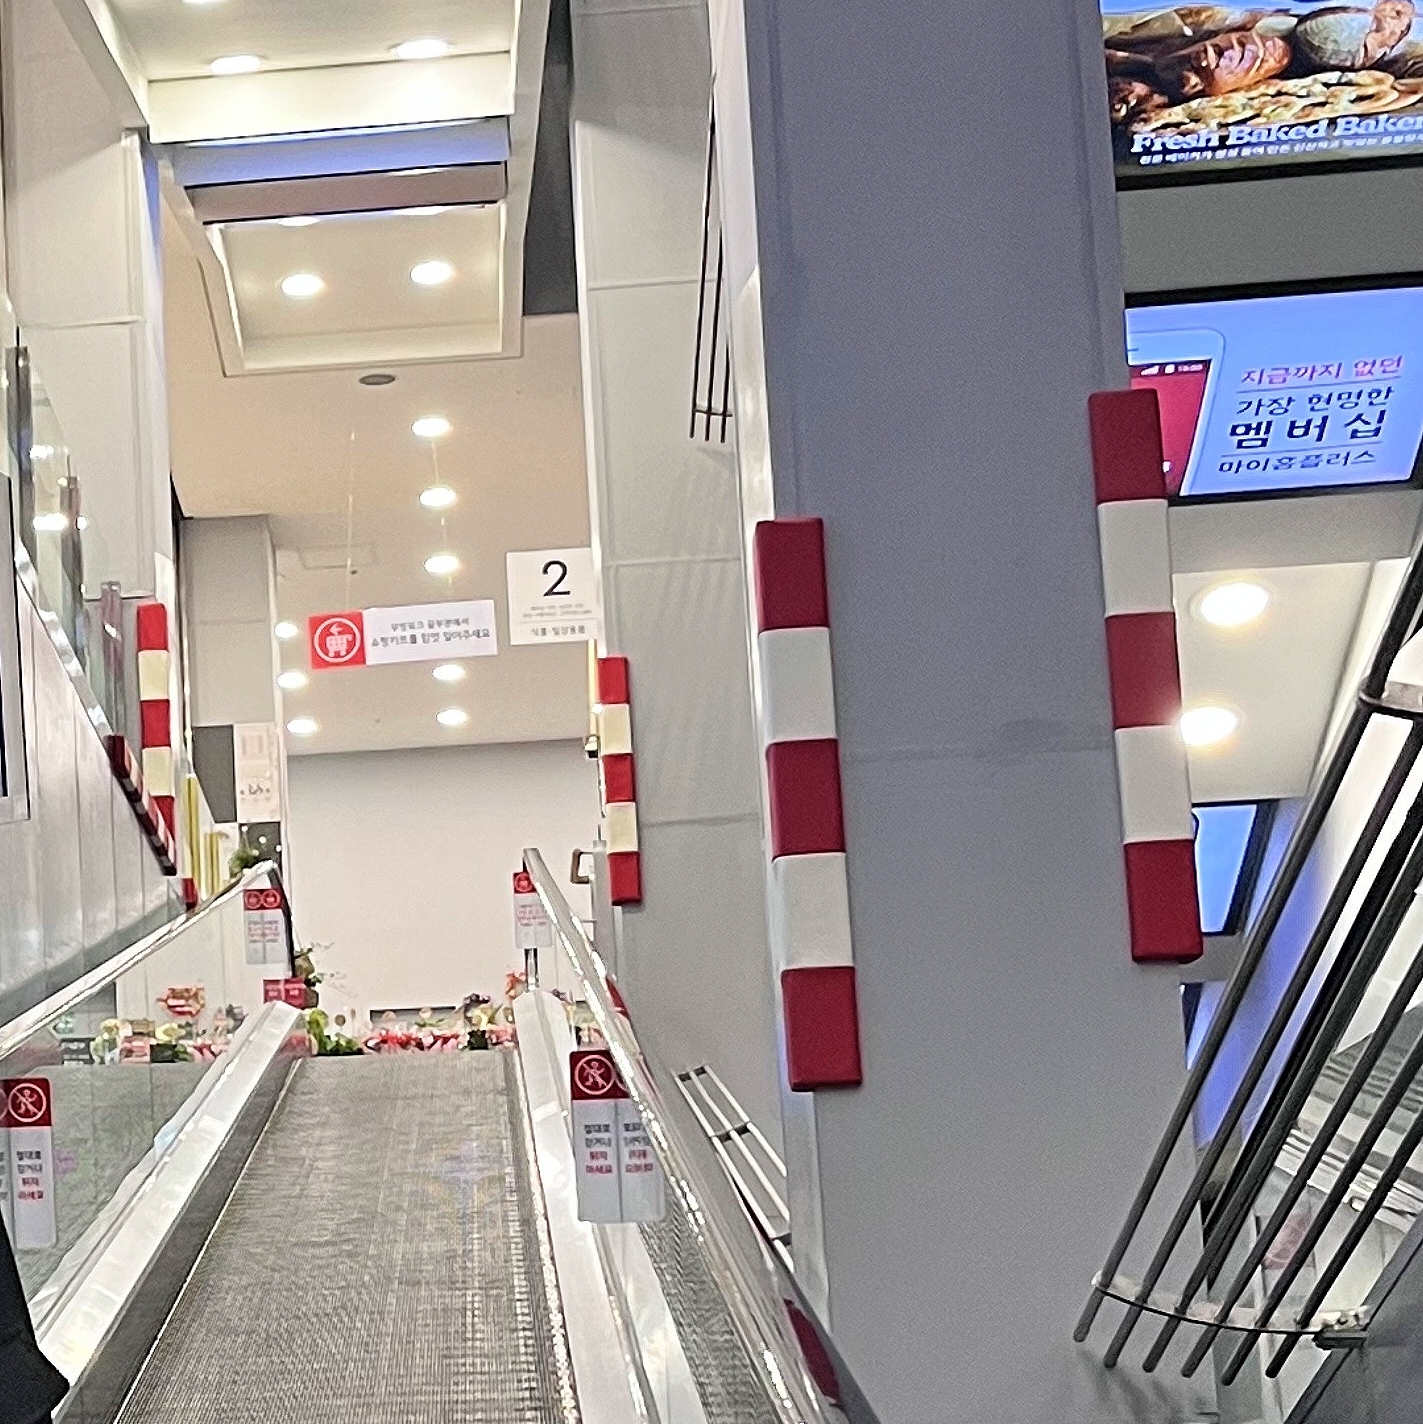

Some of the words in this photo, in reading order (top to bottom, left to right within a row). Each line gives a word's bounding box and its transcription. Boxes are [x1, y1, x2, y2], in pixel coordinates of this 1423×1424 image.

[1131, 129, 1219, 152] Fresh
[1226, 119, 1328, 146] Baked
[1241, 361, 1343, 385] 지금까지
[1353, 355, 1404, 378] 없던
[1236, 395, 1296, 417] 가장
[1307, 386, 1395, 412] 현명한
[1218, 449, 1377, 474] 마이홈플러스
[542, 559, 571, 597] 2
